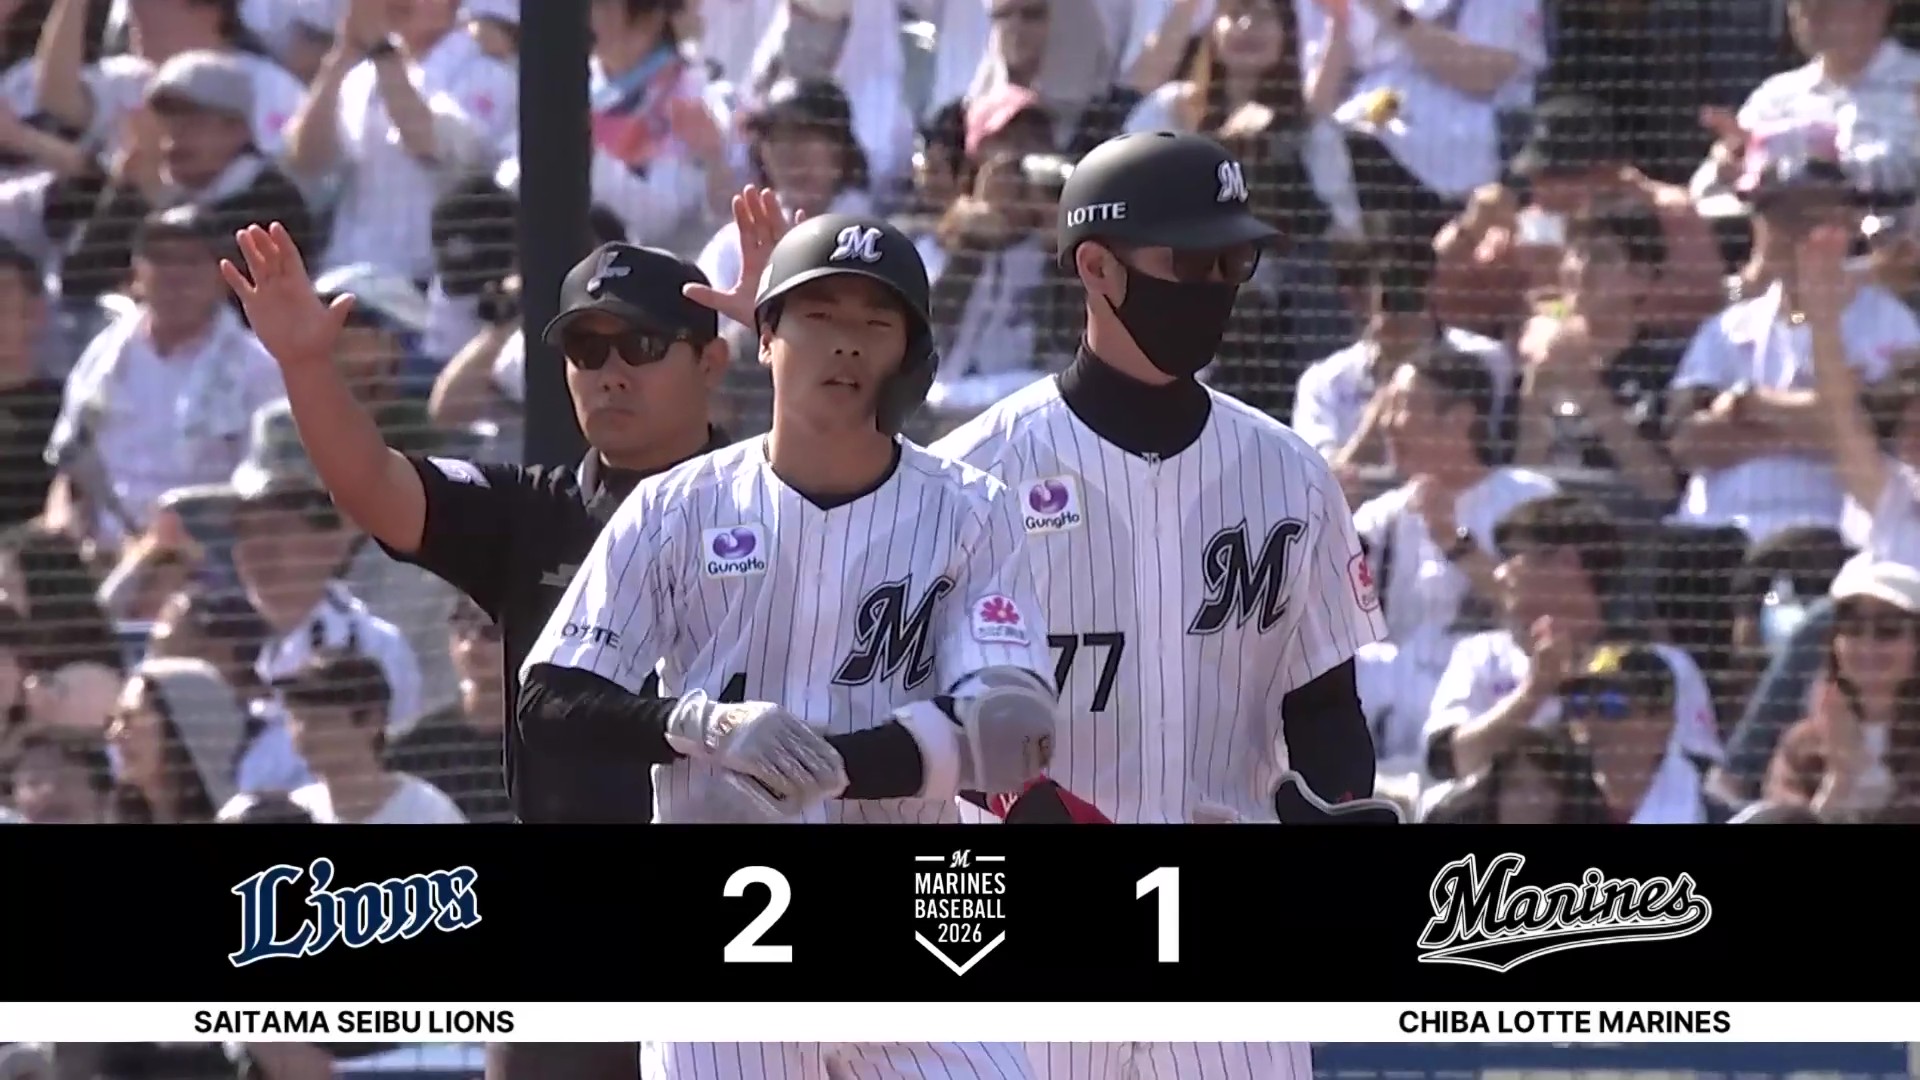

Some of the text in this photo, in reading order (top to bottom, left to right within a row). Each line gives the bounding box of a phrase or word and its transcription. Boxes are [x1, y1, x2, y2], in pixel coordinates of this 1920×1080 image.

[1217, 159, 1248, 202] M
[1067, 201, 1127, 227] LOTTE
[829, 224, 884, 263] M
[1025, 511, 1080, 530] GungHo
[707, 556, 766, 576] GungHo
[1187, 517, 1308, 635] M
[555, 622, 620, 650] OTTE
[831, 573, 956, 691] M
[1047, 632, 1125, 712] 77
